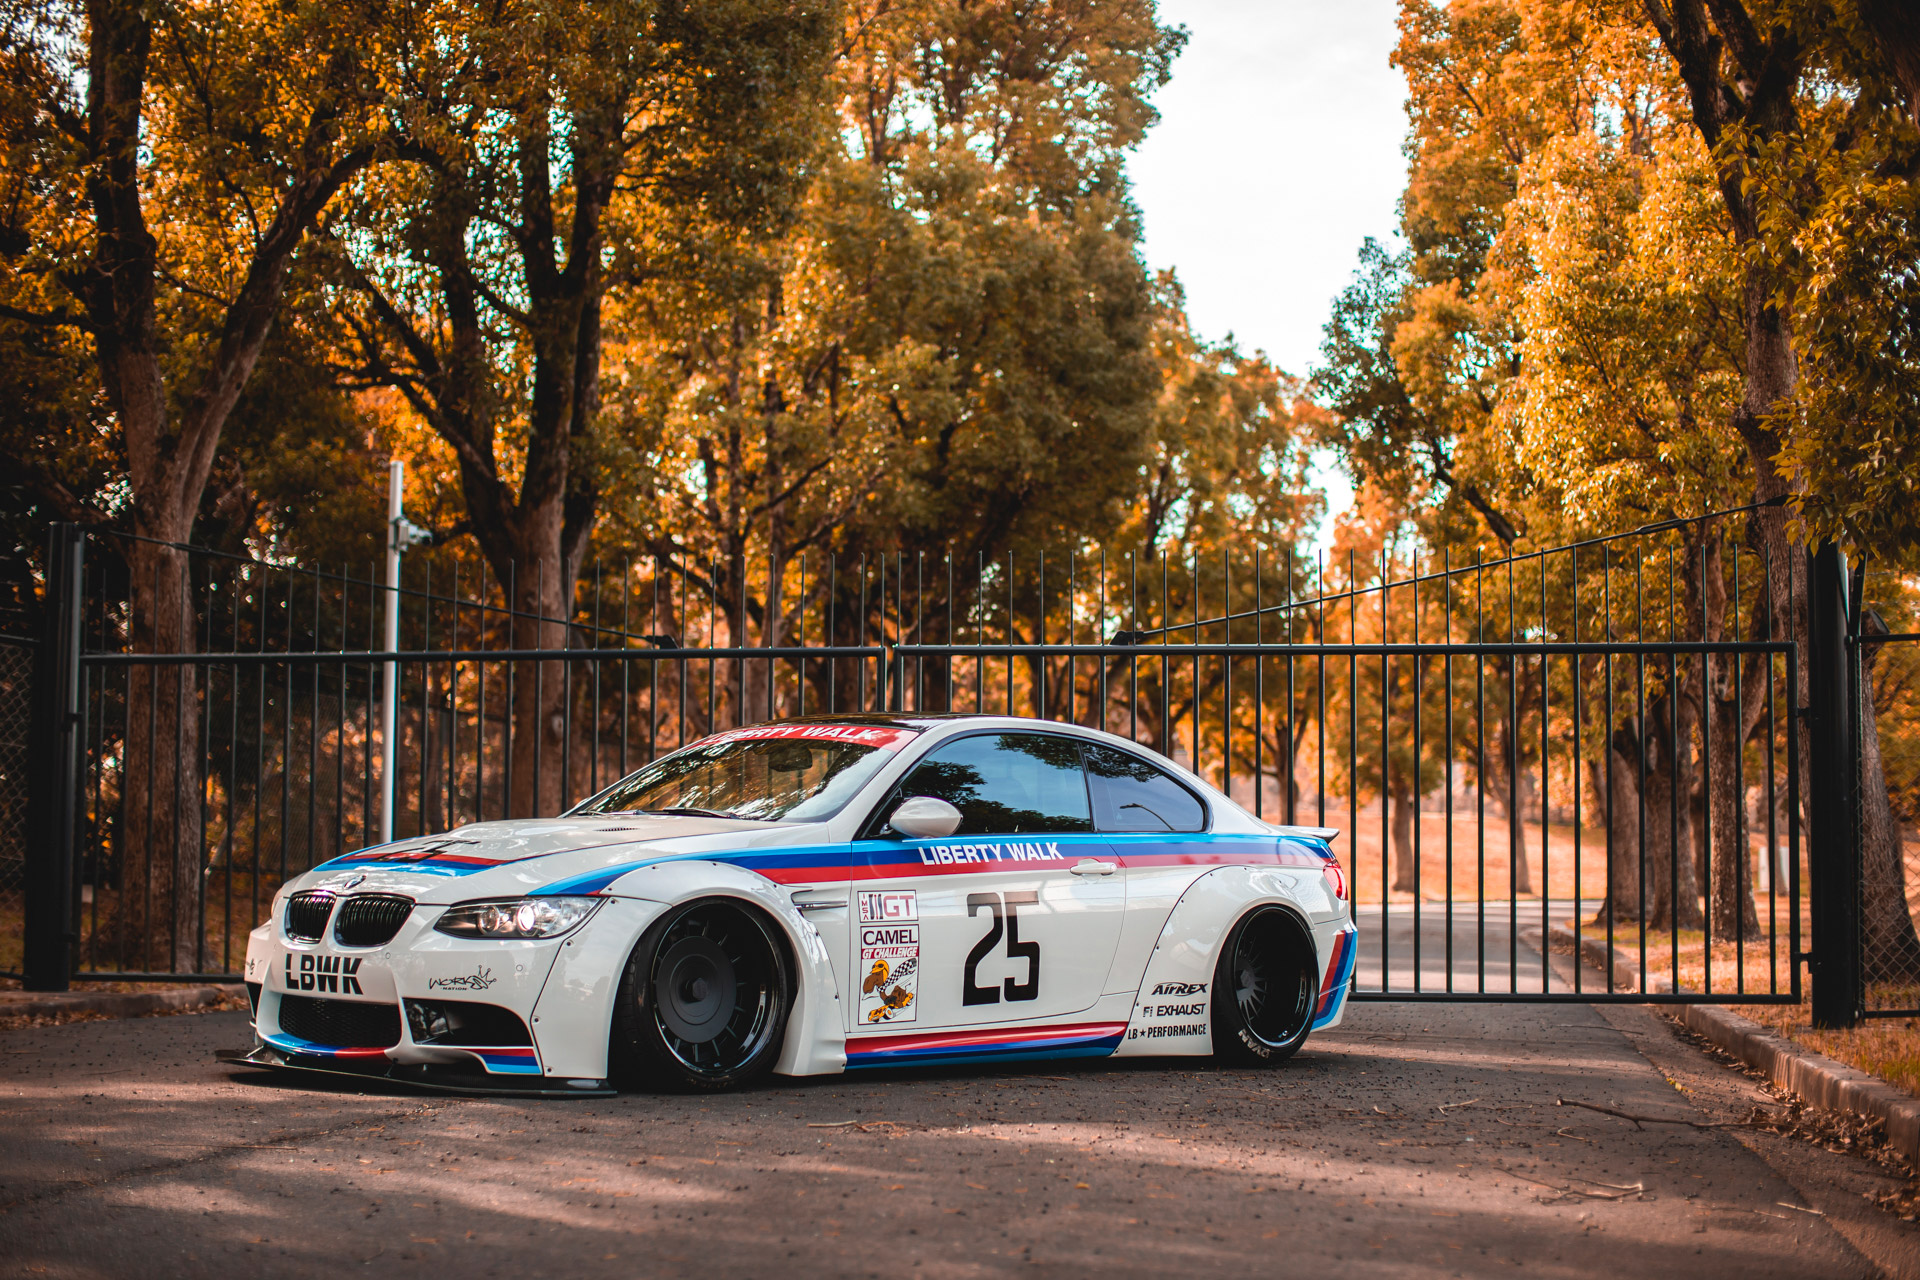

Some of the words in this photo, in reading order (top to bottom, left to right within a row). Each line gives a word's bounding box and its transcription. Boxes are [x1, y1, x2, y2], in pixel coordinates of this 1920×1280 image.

[800, 726, 883, 741] WALK
[918, 843, 1003, 866] LIBERTY
[1005, 841, 1065, 862] WALK
[883, 894, 915, 917] GT
[863, 929, 918, 946] CAMEL
[862, 948, 874, 959] GT
[873, 946, 918, 959] CHALLENGE
[962, 890, 1041, 1007] 25
[285, 953, 364, 995] LBWK
[1156, 1003, 1207, 1017] EXHAUST
[1127, 1028, 1139, 1040] LB
[1147, 1023, 1207, 1039] PERFORMANCE
